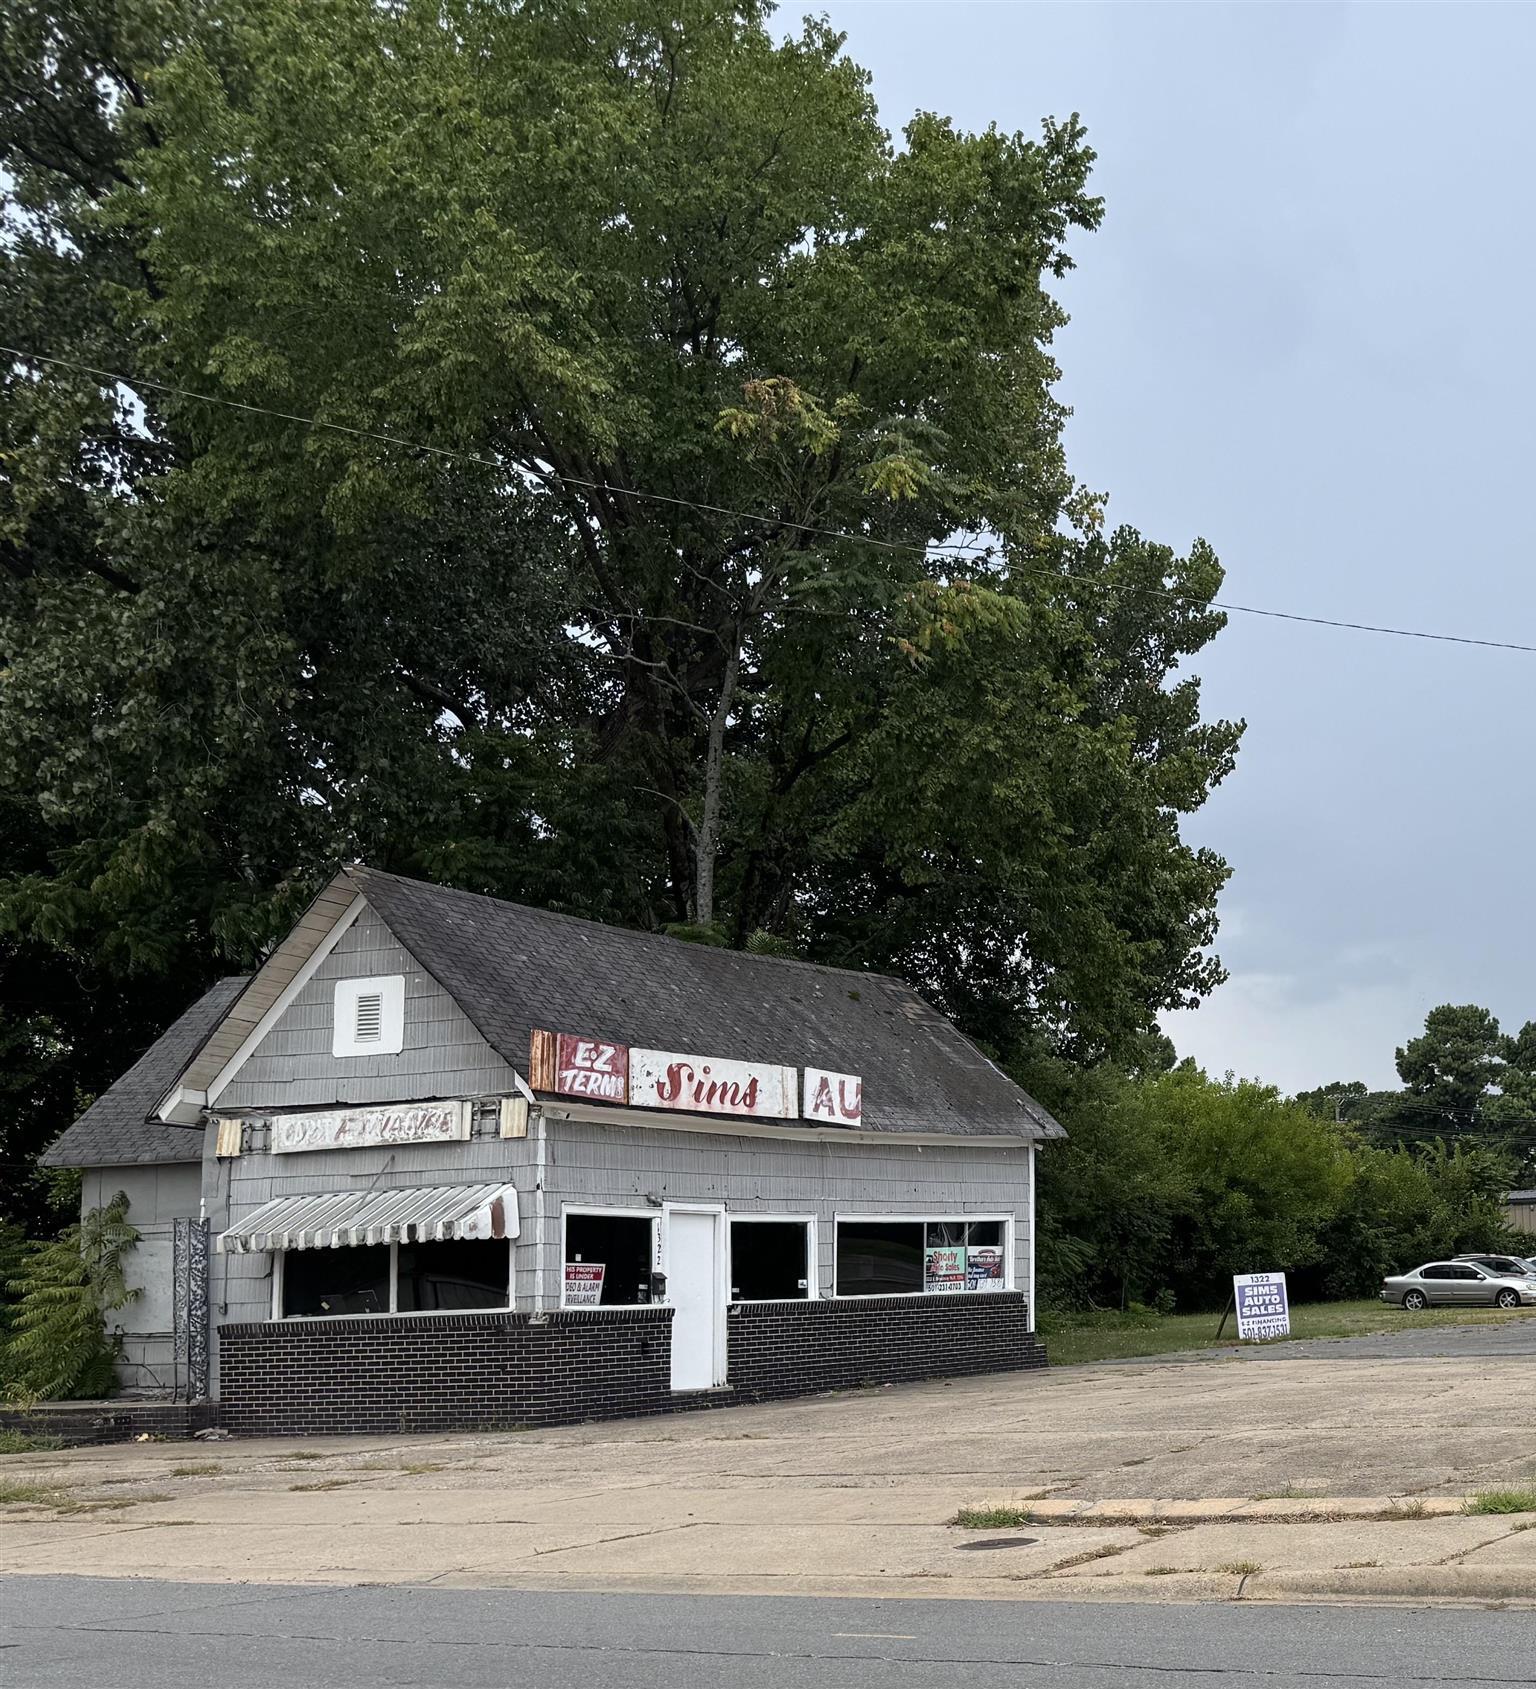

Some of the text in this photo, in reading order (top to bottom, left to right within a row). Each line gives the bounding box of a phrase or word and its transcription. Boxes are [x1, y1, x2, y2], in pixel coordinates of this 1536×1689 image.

[560, 1069, 625, 1099] TERMS
[656, 1062, 759, 1108] Sims
[1250, 1275, 1270, 1283] 1322
[1244, 1285, 1278, 1297] SIMS
[1243, 1294, 1281, 1307] AUTO
[1241, 1304, 1284, 1317] SALES
